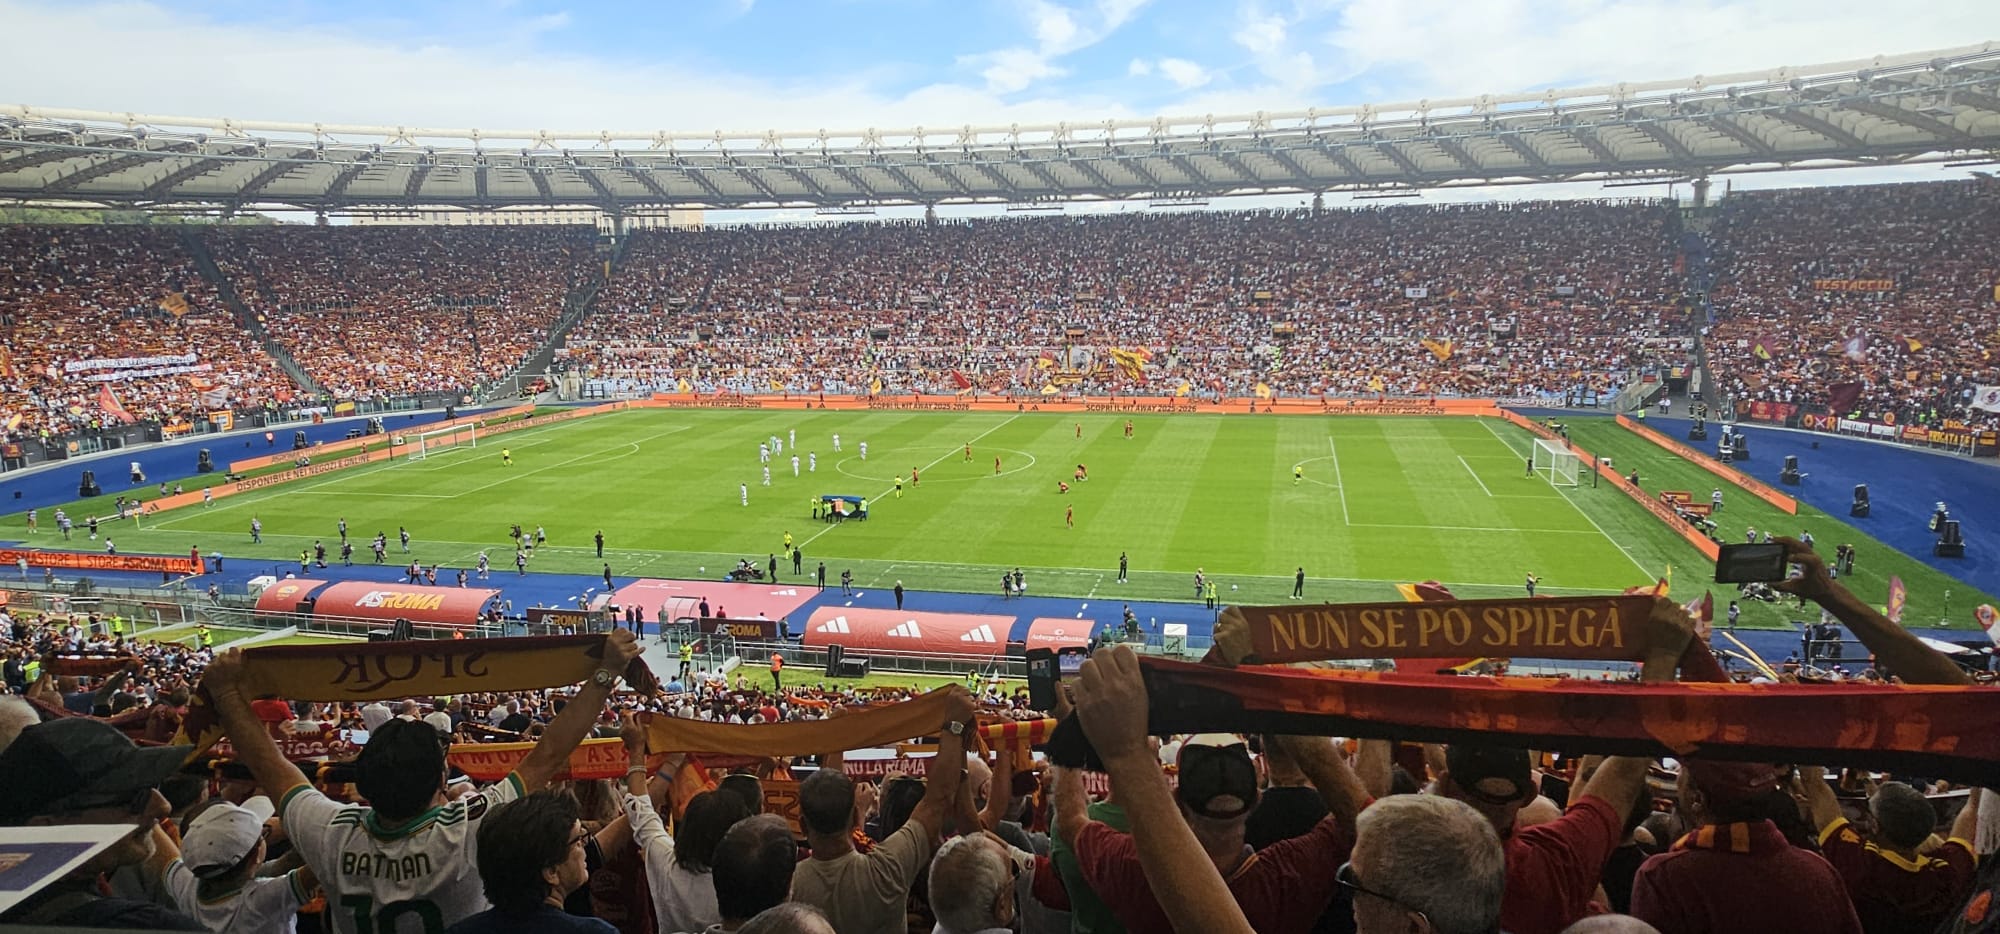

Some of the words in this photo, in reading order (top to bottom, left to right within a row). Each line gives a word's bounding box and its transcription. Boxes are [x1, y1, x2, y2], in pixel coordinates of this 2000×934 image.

[1813, 279, 1893, 291] TESTACCIO
[868, 402, 893, 410] SCOPRI
[914, 402, 931, 410] AWAY
[1086, 404, 1114, 412] SCOPRI
[1123, 404, 1135, 412] KIT
[1136, 404, 1157, 412] AWAY
[1324, 406, 1354, 414] SCOPRI
[1378, 406, 1400, 414] AWAY
[236, 472, 290, 491] DISPONIBILE
[292, 468, 308, 480] NEI
[309, 462, 337, 476] NEGOZI
[338, 460, 343, 468] E
[344, 454, 370, 467] ONLINE
[1269, 611, 1349, 652] NUN
[1360, 608, 1407, 648] SE
[1417, 607, 1471, 646] PO
[1481, 601, 1624, 648] SPIEGÀ
[866, 760, 884, 775] LA
[343, 852, 431, 882] BATMAN
